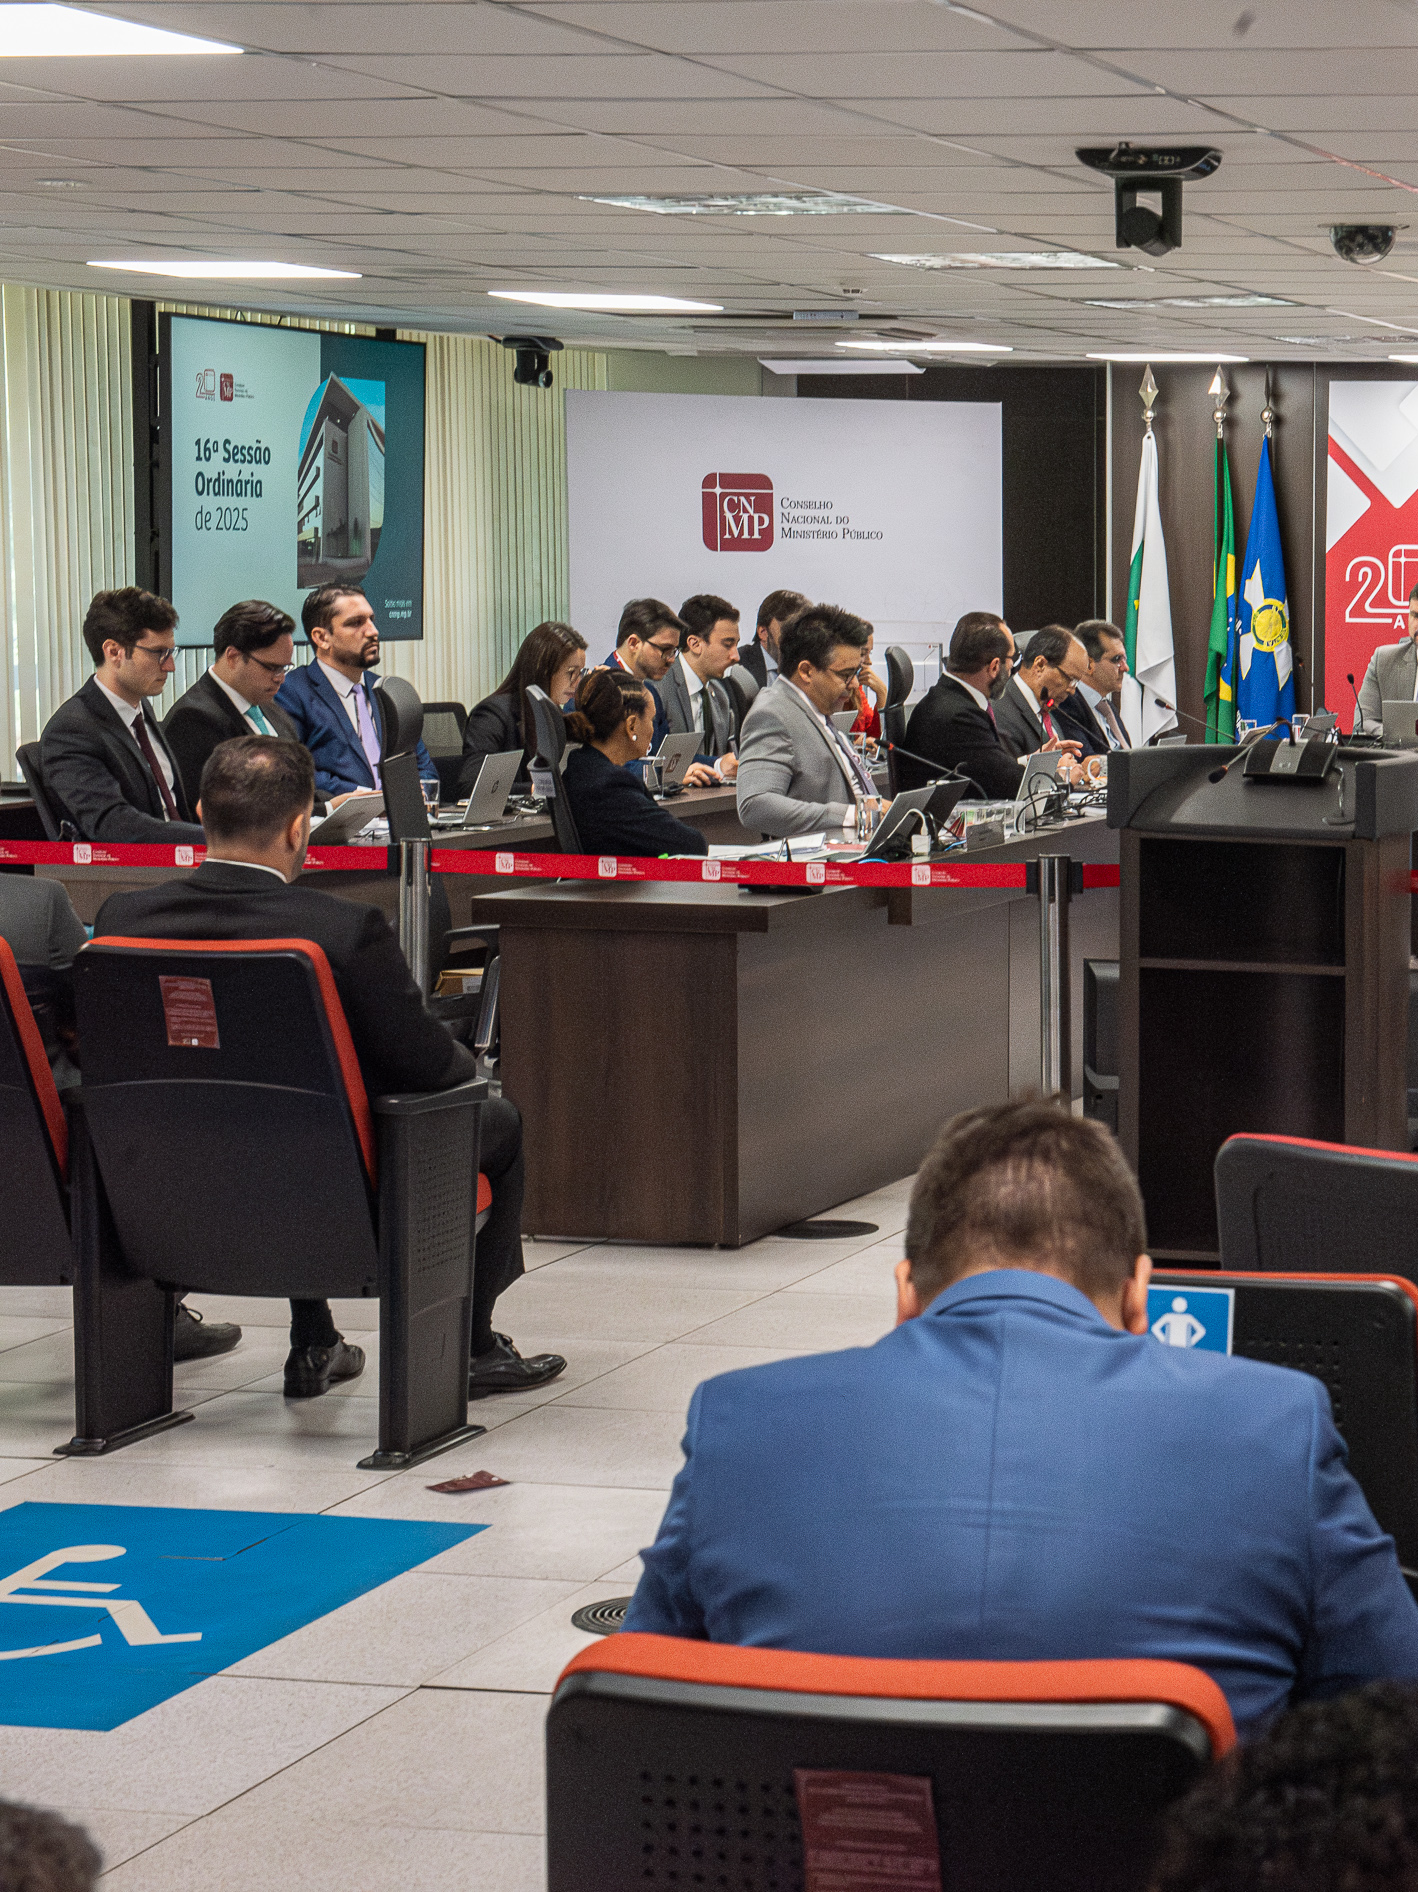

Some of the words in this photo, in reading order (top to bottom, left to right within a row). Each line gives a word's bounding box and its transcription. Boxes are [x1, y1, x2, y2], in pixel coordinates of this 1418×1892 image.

[195, 438, 219, 462] 16ª
[222, 439, 271, 465] Sessão
[195, 469, 262, 498] Ordinária
[195, 505, 212, 531] de
[215, 506, 249, 531] 2025
[723, 495, 756, 516] CN
[723, 513, 770, 539] MP
